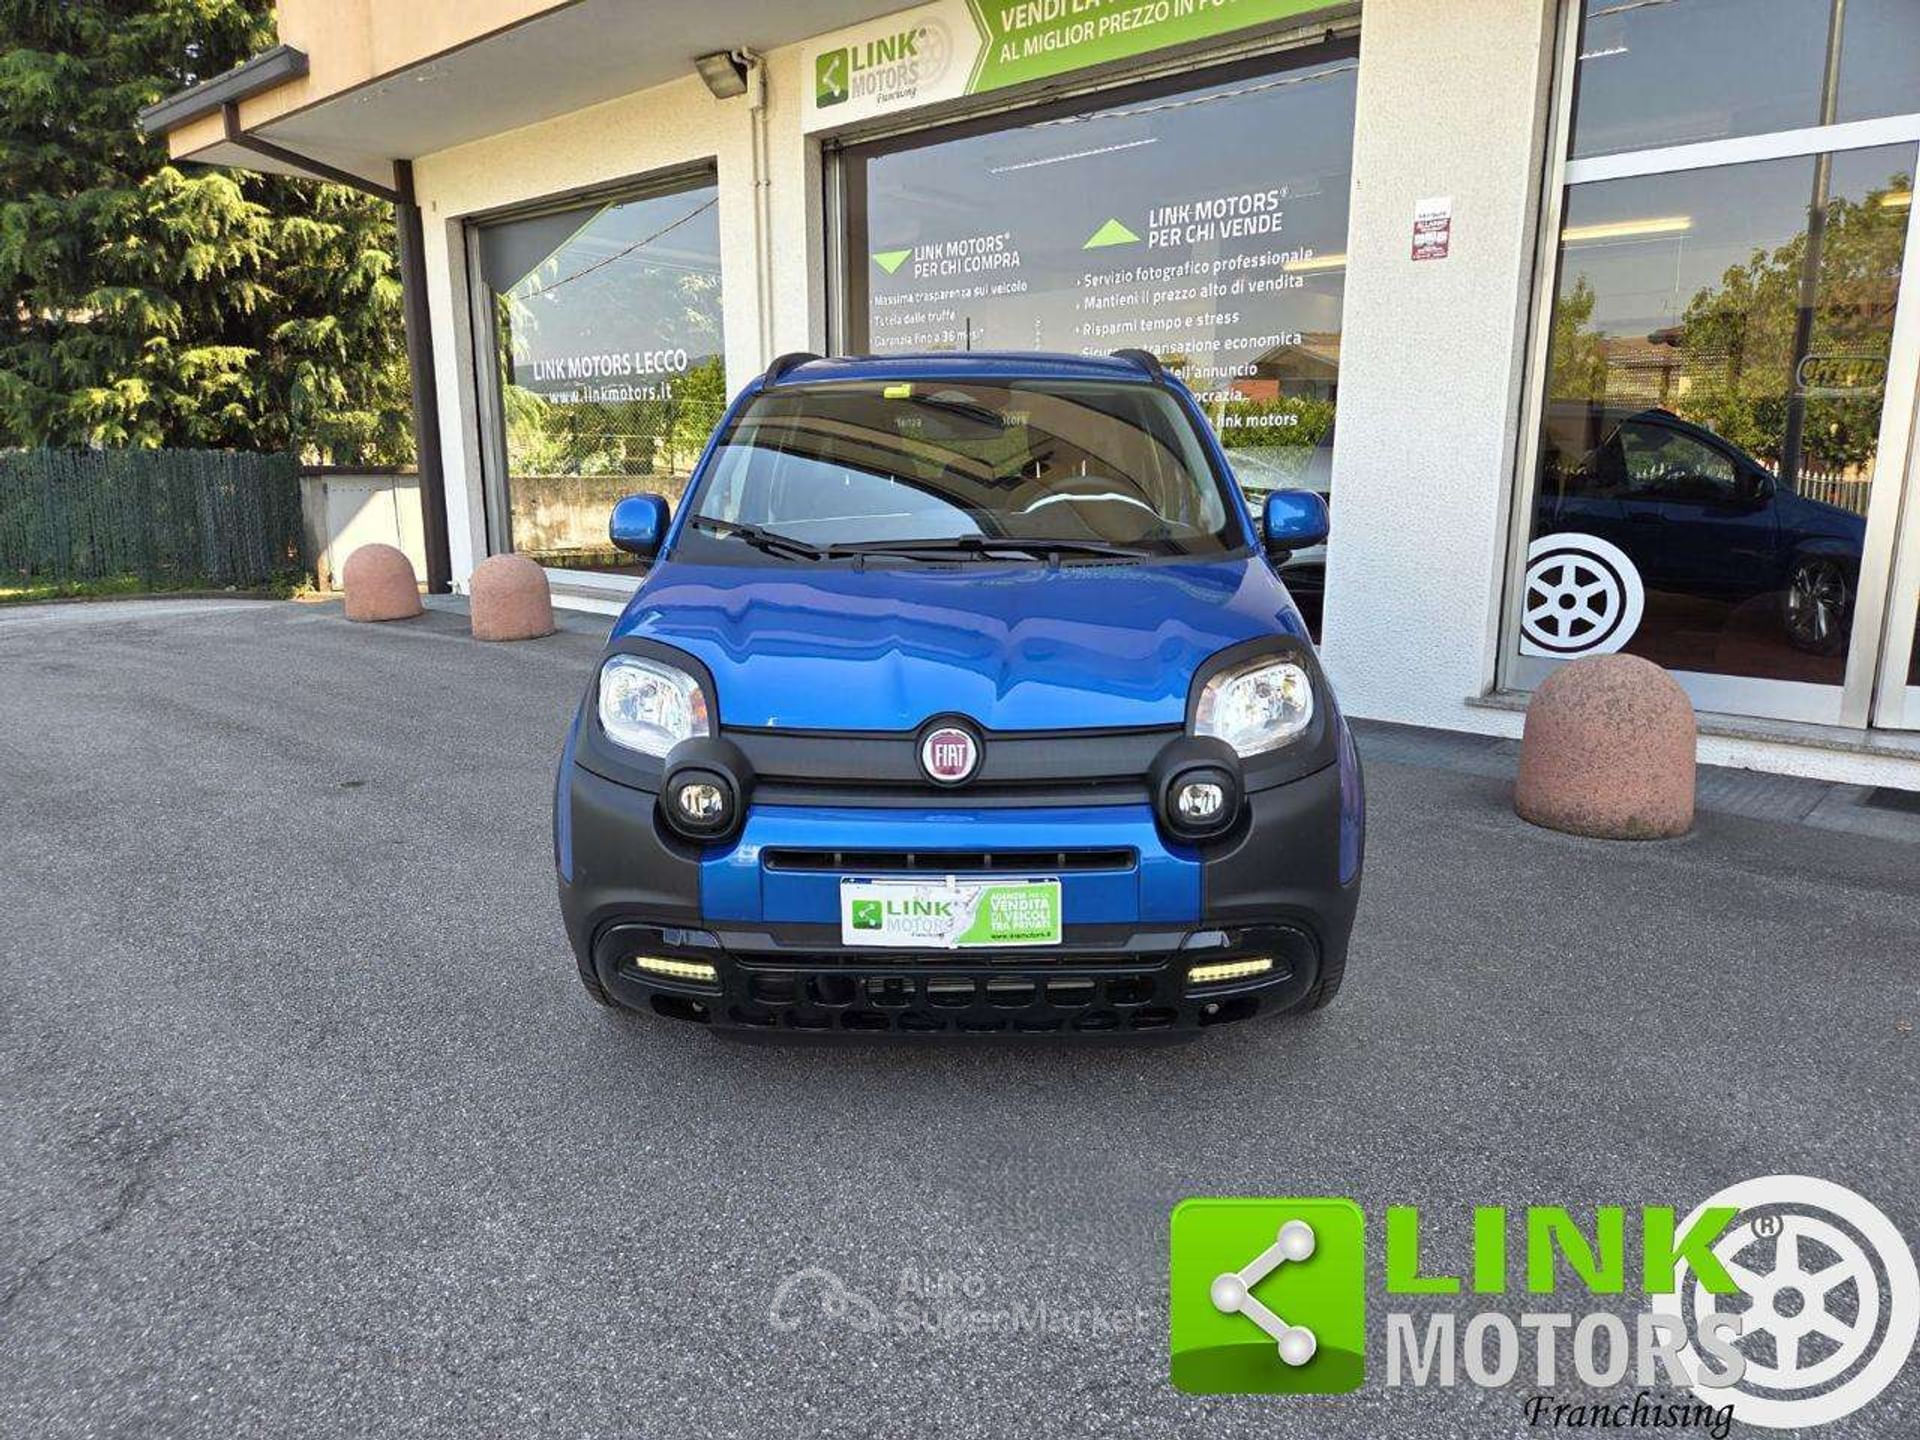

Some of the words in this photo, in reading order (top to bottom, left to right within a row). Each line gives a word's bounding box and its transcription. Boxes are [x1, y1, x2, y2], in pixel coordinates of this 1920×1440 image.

[1002, 0, 1066, 32] VENDI
[1000, 42, 1020, 63] AL
[1024, 21, 1095, 57] MIGLIOR
[1099, 1, 1170, 37] PREZZO
[852, 29, 918, 72] LINK
[852, 60, 919, 98] MOTORS
[1149, 206, 1189, 228] LINK
[1149, 229, 1181, 249] PER
[1185, 224, 1215, 243] CHI
[1220, 212, 1284, 239] VENDE
[914, 243, 943, 262] LINK
[914, 261, 938, 279] PER
[940, 258, 961, 275] CHI
[964, 250, 1021, 273] COMPRA
[1084, 268, 1133, 288] Servizio
[1136, 259, 1210, 284] fotografico
[1213, 247, 1313, 278] professionale
[874, 292, 914, 307] Massima
[991, 280, 1028, 294] veicolo
[1084, 291, 1139, 310] Mantieni
[1143, 291, 1150, 304] il
[1153, 286, 1197, 307] prezzo
[1200, 280, 1227, 298] alto
[1231, 277, 1245, 295] di
[1248, 274, 1304, 292] vendita
[903, 311, 926, 325] dalle
[928, 308, 956, 323] truffe
[1083, 320, 1137, 338] Risparmi
[1141, 318, 1181, 333] tempo
[1185, 316, 1193, 327] e
[1197, 311, 1240, 327] stress
[942, 329, 955, 343] 36
[1143, 336, 1220, 355] transazione
[1225, 330, 1302, 350] economica
[533, 357, 566, 381] LINK
[567, 352, 631, 379] MOTORS
[635, 348, 688, 374] LECCO
[1171, 361, 1258, 378] ell'annuncio
[1217, 413, 1243, 428] link
[1246, 413, 1299, 427] motors
[935, 743, 966, 767] FIAT
[886, 901, 951, 916] LINK
